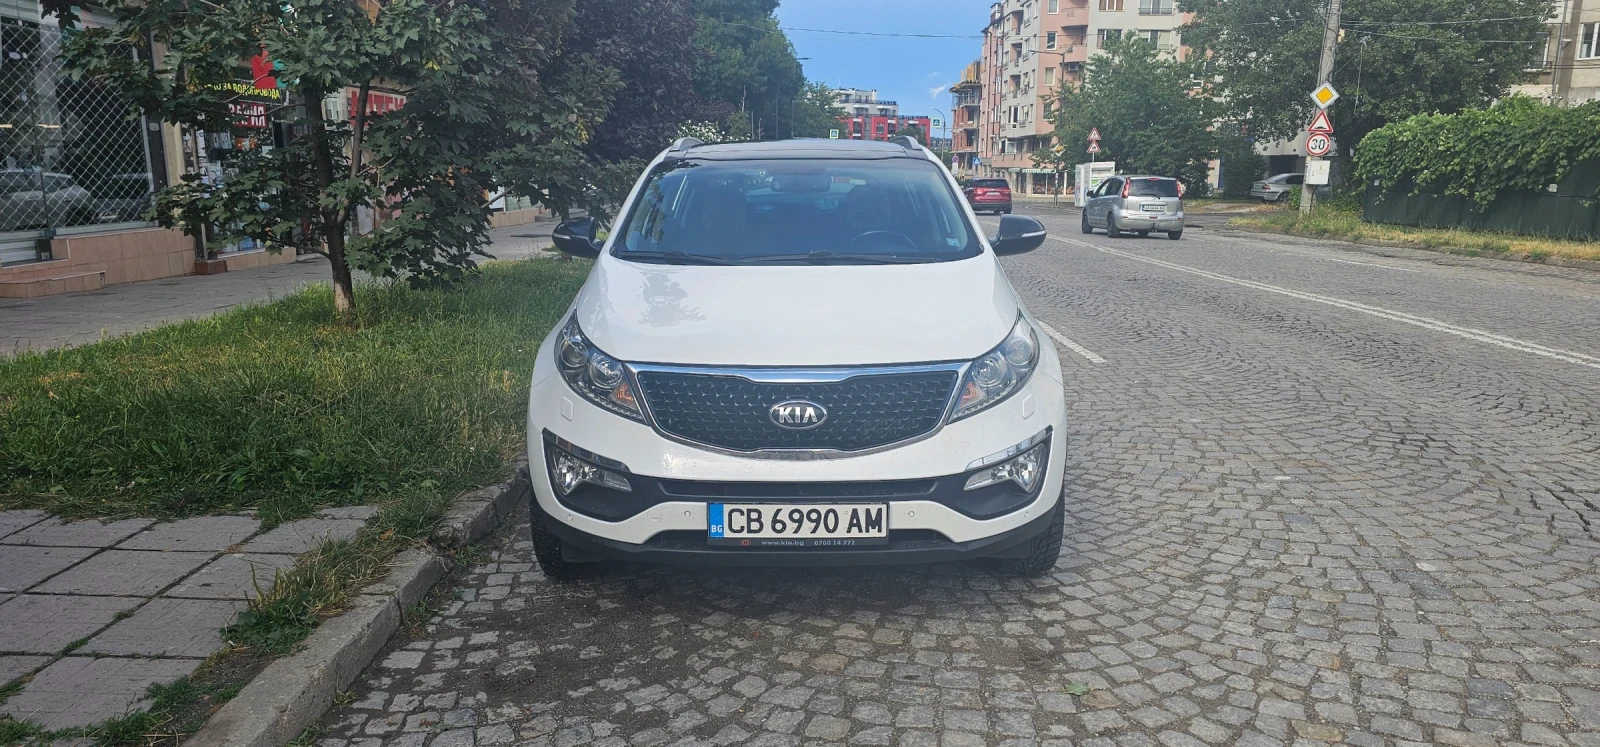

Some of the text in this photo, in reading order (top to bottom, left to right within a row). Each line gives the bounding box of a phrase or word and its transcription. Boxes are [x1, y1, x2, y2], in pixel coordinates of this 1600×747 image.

[1311, 138, 1326, 150] 30
[777, 406, 818, 423] KIA
[727, 507, 883, 534] CB 6990 AM
[711, 524, 723, 533] BG
